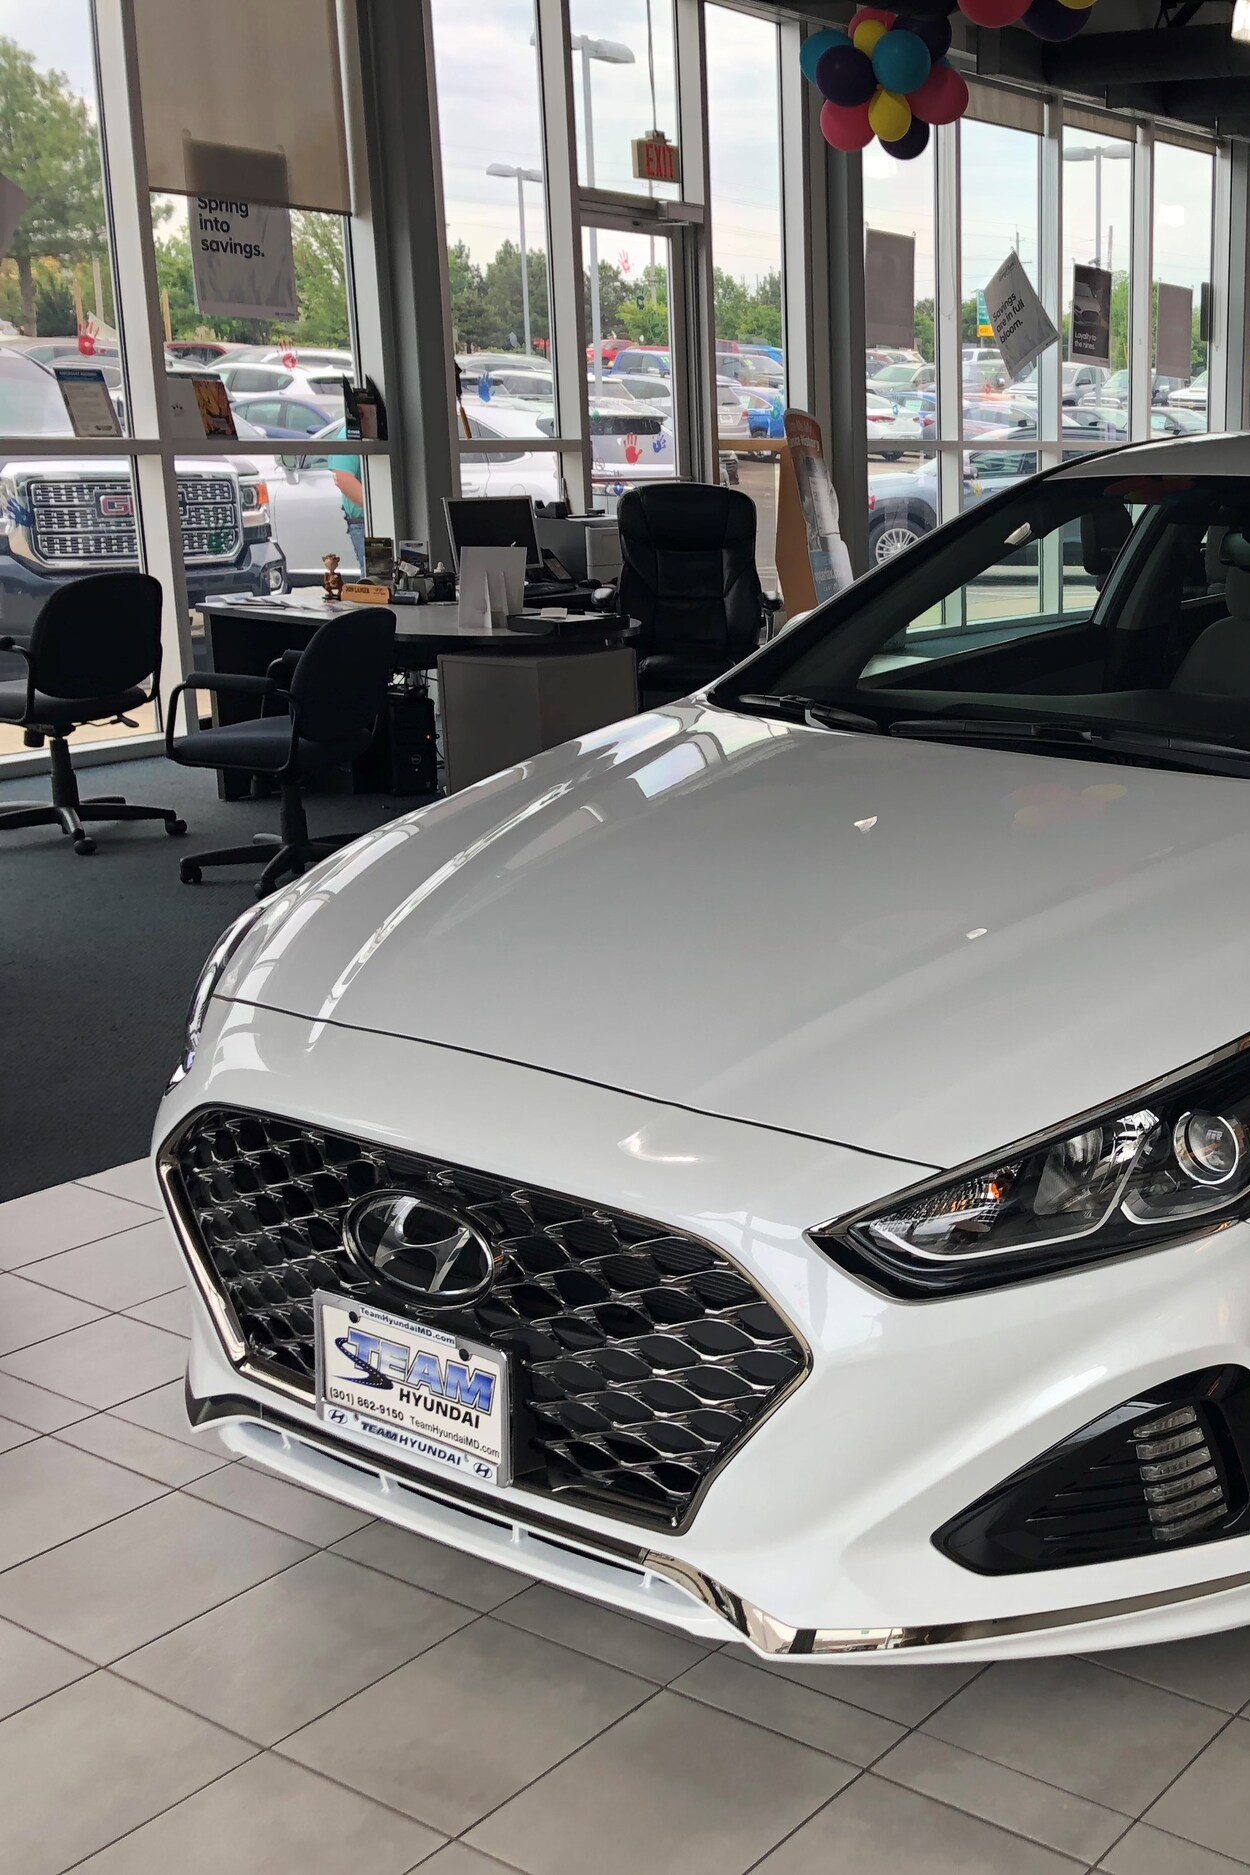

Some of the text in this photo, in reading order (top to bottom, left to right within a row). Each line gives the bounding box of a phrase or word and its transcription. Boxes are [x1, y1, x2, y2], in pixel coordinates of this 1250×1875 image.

[645, 143, 673, 178] EXIT
[198, 197, 249, 218] Spring
[199, 213, 230, 233] into
[201, 237, 264, 259] savings.
[993, 293, 1017, 321] Savings
[996, 299, 1025, 333] are in full
[1000, 320, 1024, 344] bloom.
[1074, 331, 1091, 342] Loyalty
[359, 1307, 456, 1345] TeamHyundaiMD.com
[347, 1326, 497, 1416] TEAM
[329, 1386, 500, 1459] (301) 862-9150 TeamHyundaiMD.com
[399, 1388, 480, 1429] HYUNDAI
[361, 1421, 462, 1466] TEAM HYUNDAI
